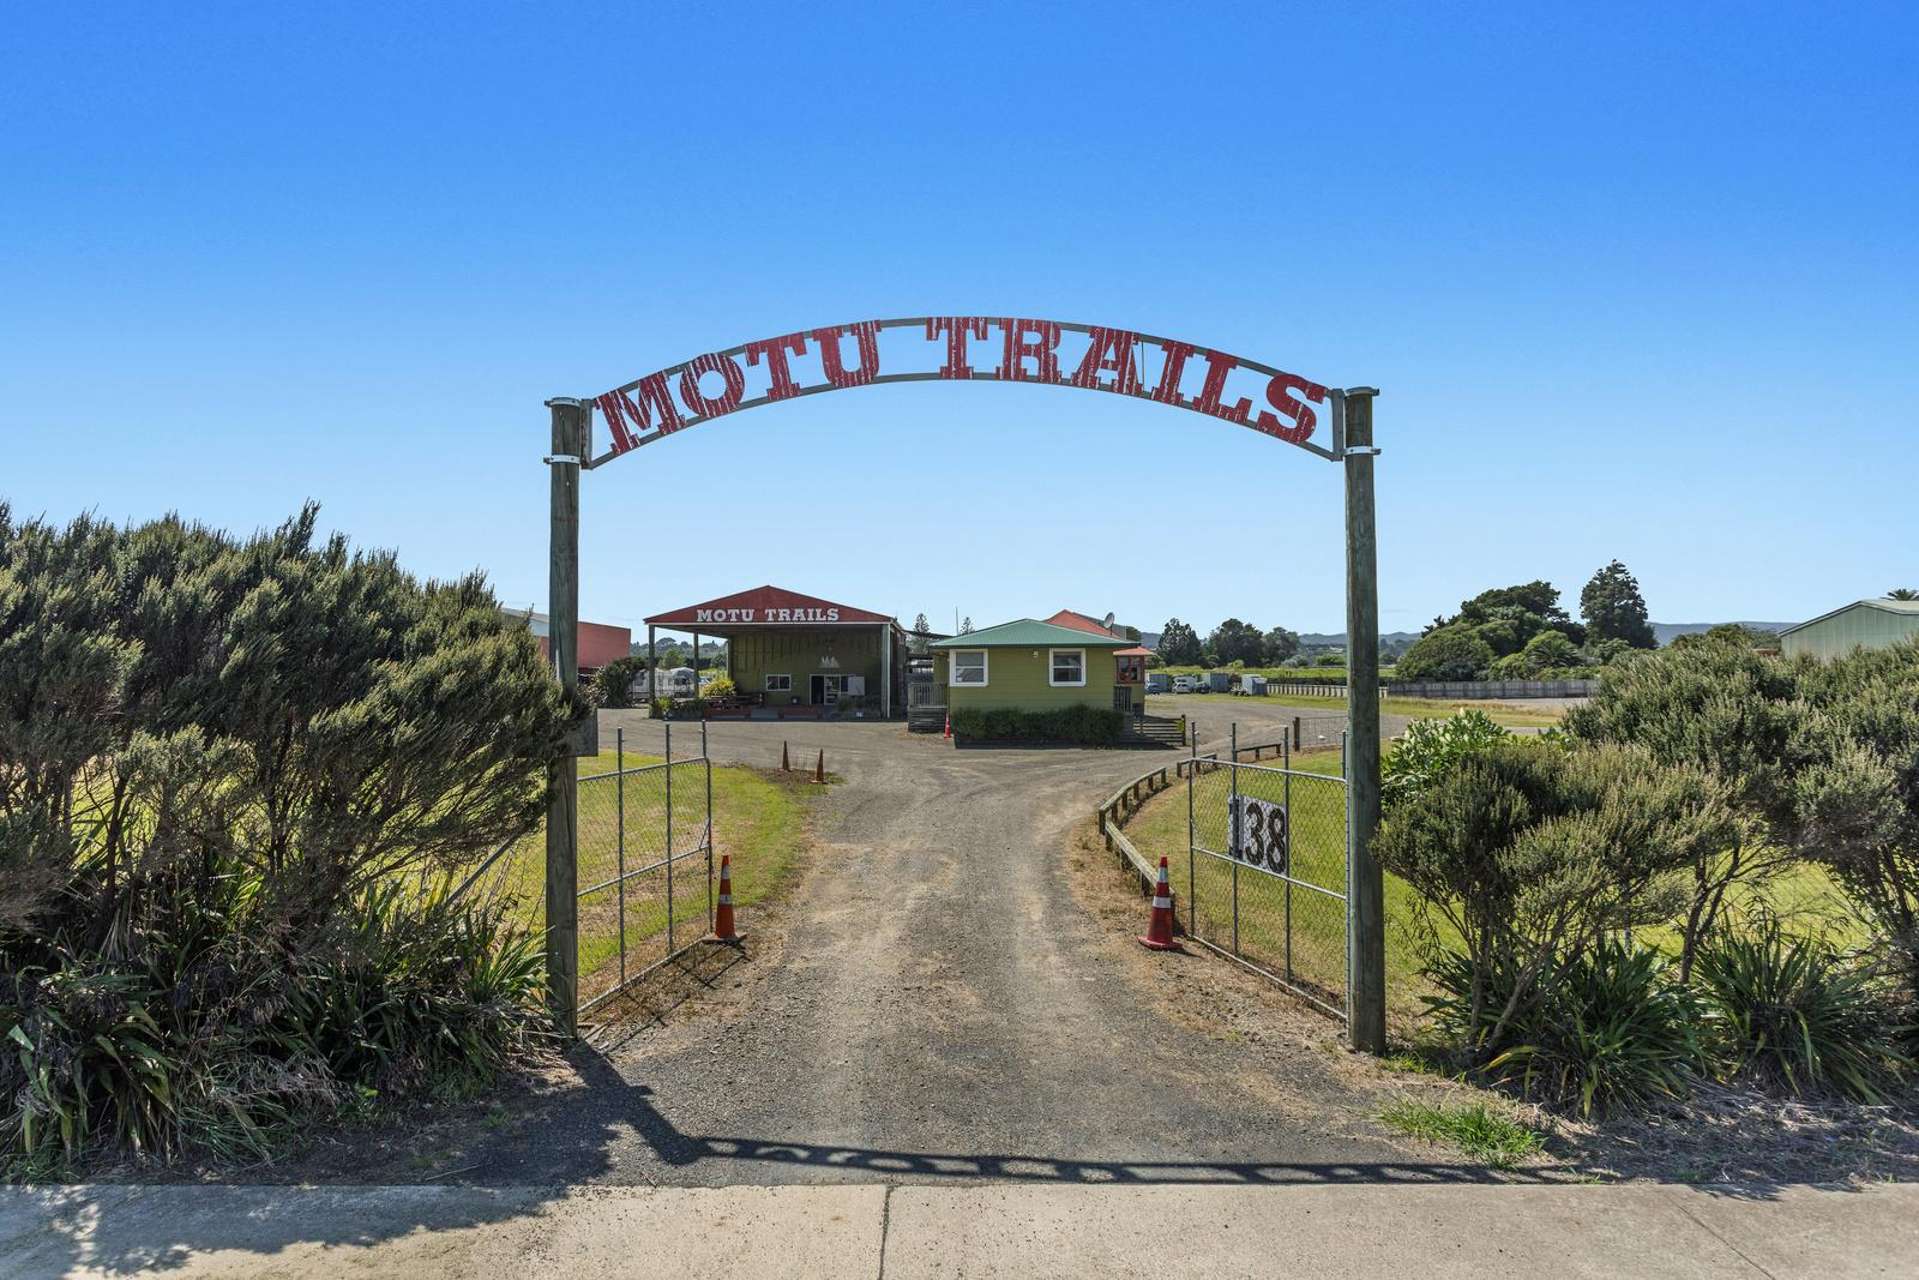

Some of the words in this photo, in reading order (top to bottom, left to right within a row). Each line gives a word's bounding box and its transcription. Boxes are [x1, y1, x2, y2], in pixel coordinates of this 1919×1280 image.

[594, 319, 881, 455] MOTU
[926, 317, 1327, 444] TRAILS
[696, 609, 755, 622] MOTU
[765, 608, 839, 622] TRAILS
[1229, 798, 1286, 874] 138
